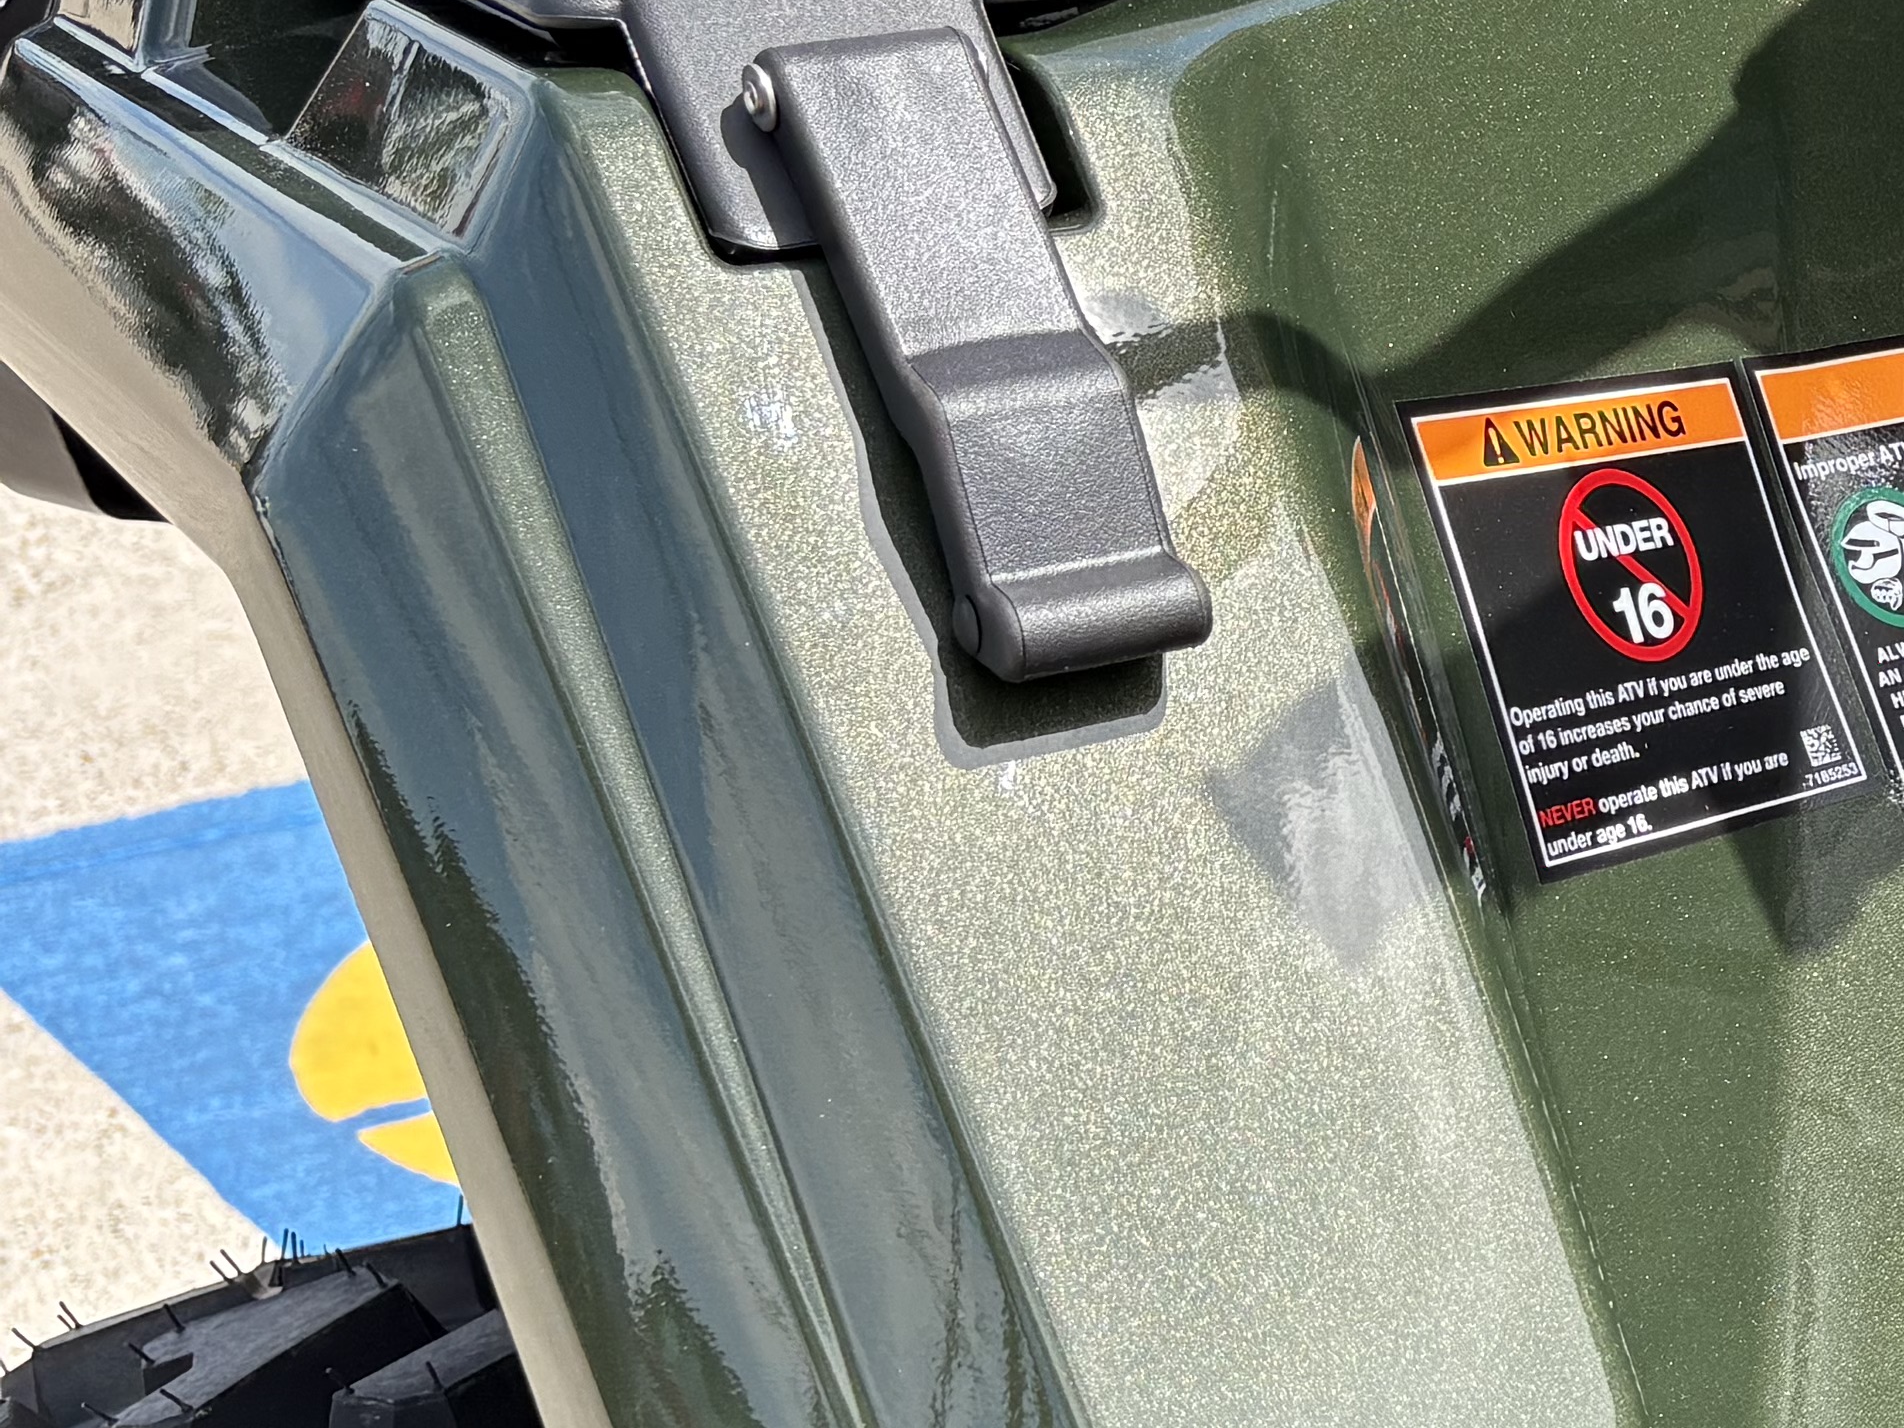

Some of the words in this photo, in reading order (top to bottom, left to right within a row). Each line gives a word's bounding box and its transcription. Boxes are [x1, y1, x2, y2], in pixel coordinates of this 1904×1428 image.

[1513, 400, 1686, 457] WARNING
[1793, 446, 1879, 481] Improper
[1574, 517, 1674, 561] UNDER
[1613, 583, 1674, 643] 16
[1509, 697, 1586, 728] Operating
[1585, 688, 1616, 710] this
[1617, 679, 1645, 703] ATV
[1646, 676, 1659, 696] if
[1659, 675, 1688, 697] you
[1688, 669, 1713, 687] are
[1714, 658, 1754, 681] under
[1755, 652, 1780, 671] the
[1780, 647, 1811, 667] age
[1878, 667, 1903, 688] AN
[1518, 733, 1536, 756] of
[1537, 729, 1558, 750] 16
[1557, 716, 1632, 746] increases
[1631, 708, 1665, 732] your
[1667, 696, 1720, 721] chance
[1721, 687, 1737, 707] of
[1738, 681, 1786, 704] severe
[1525, 760, 1569, 785] injury
[1571, 755, 1588, 773] or
[1591, 741, 1641, 768] death.
[1539, 797, 1596, 828] NEVER
[1598, 784, 1659, 815] operate
[1658, 775, 1690, 798] this
[1691, 765, 1719, 790] ATV
[1720, 761, 1733, 781] if
[1733, 759, 1763, 782] you
[1763, 752, 1789, 771] are
[1546, 831, 1593, 857] under
[1595, 823, 1627, 845] age
[1626, 813, 1653, 835] 16.
